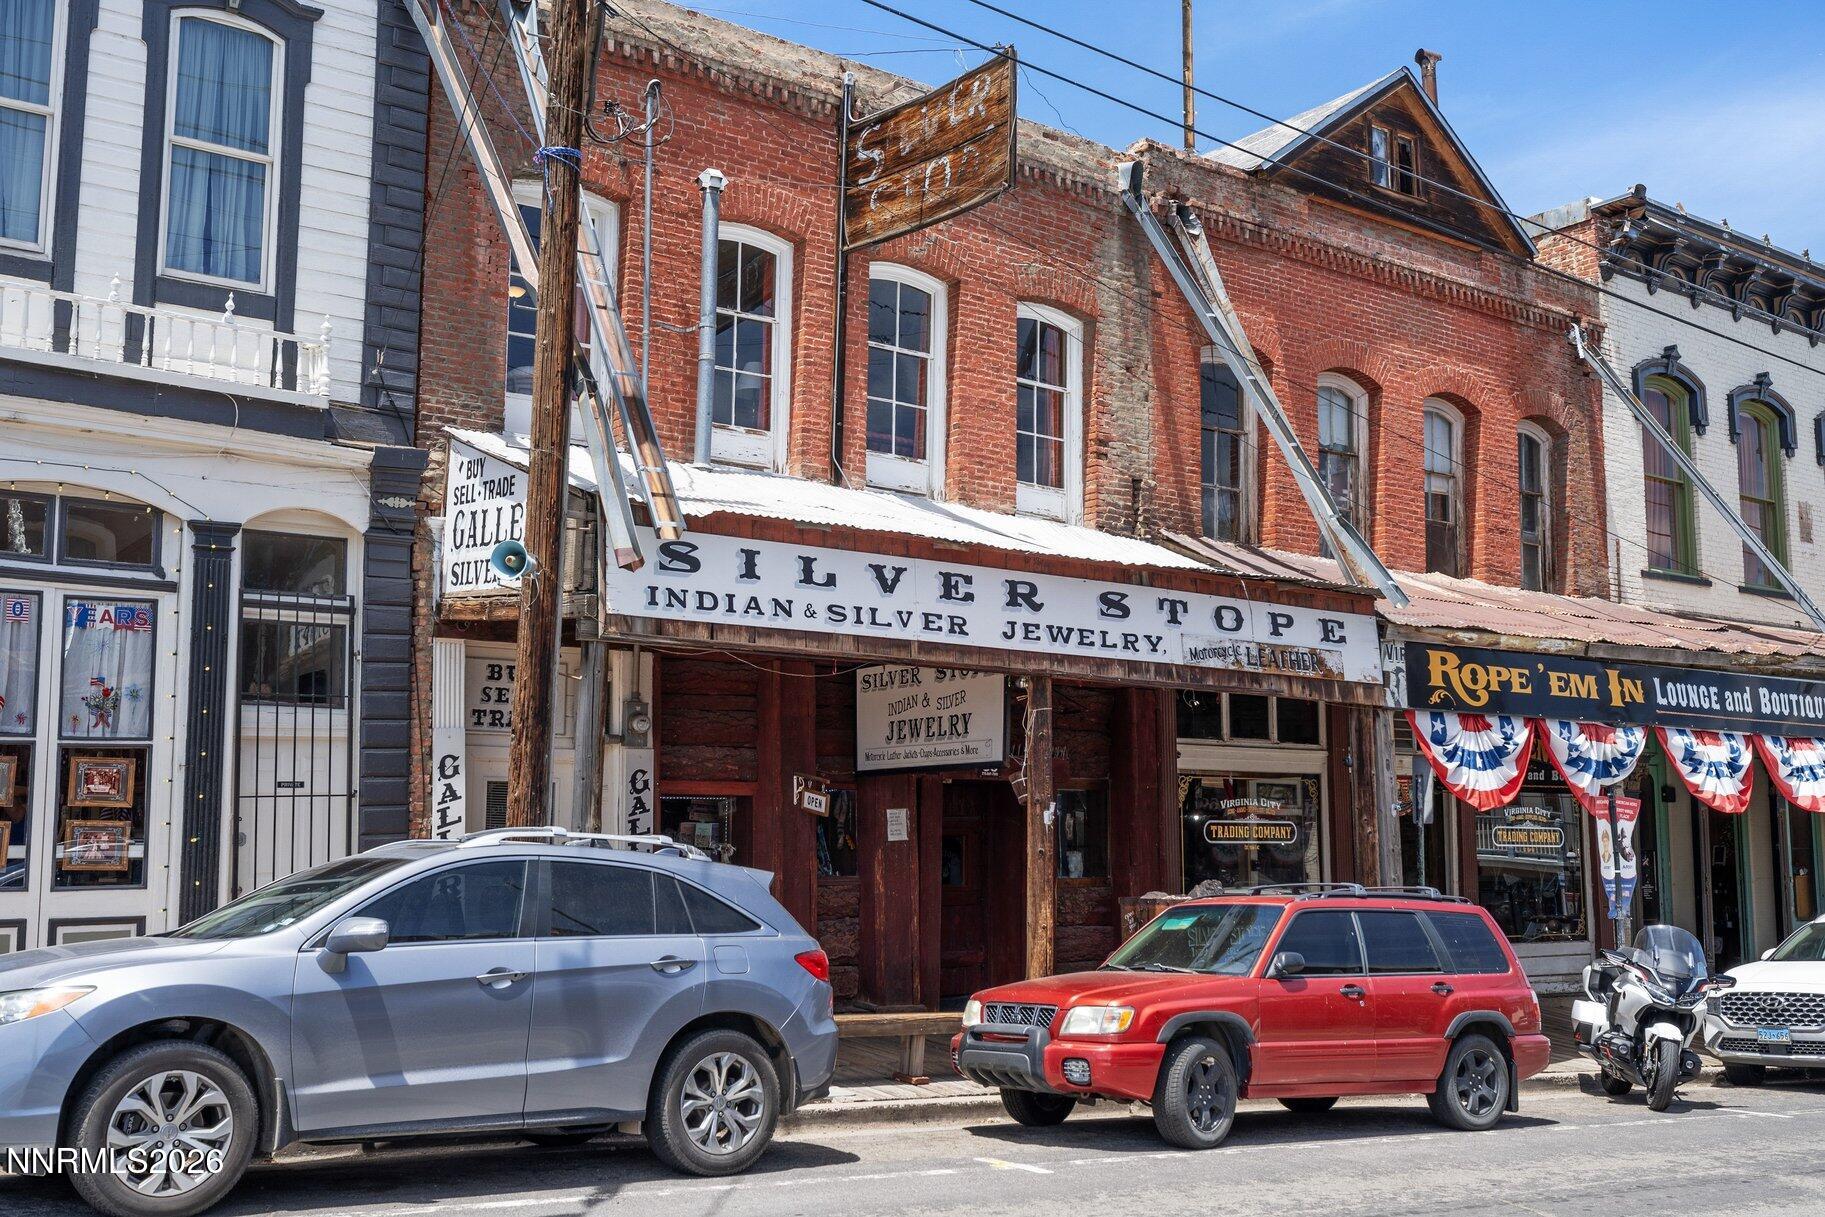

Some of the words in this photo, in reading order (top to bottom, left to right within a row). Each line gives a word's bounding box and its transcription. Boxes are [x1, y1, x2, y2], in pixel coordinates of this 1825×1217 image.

[467, 457, 486, 480] BUY
[454, 483, 476, 505] SELL
[483, 475, 516, 500] TRADE
[657, 540, 1044, 612] SILVER
[1099, 591, 1347, 644] STOPE
[67, 603, 150, 628] YEARS
[647, 586, 794, 618] INDIAN
[804, 603, 817, 619] &
[827, 604, 970, 636] SILVER
[1002, 621, 1167, 655] JEWELRY,
[862, 667, 922, 690] SILVER
[888, 693, 919, 716] INDIAN
[922, 692, 931, 708] &
[936, 690, 967, 711] SILVER
[1725, 686, 1753, 714] and
[886, 713, 972, 741] JEWELRY
[1528, 770, 1544, 780] and
[807, 795, 823, 809] OPEN
[1210, 825, 1250, 838] TRADING
[1252, 826, 1292, 839] COMPANY
[1497, 831, 1528, 842] TRADING
[1530, 831, 1560, 842] COMPANY
